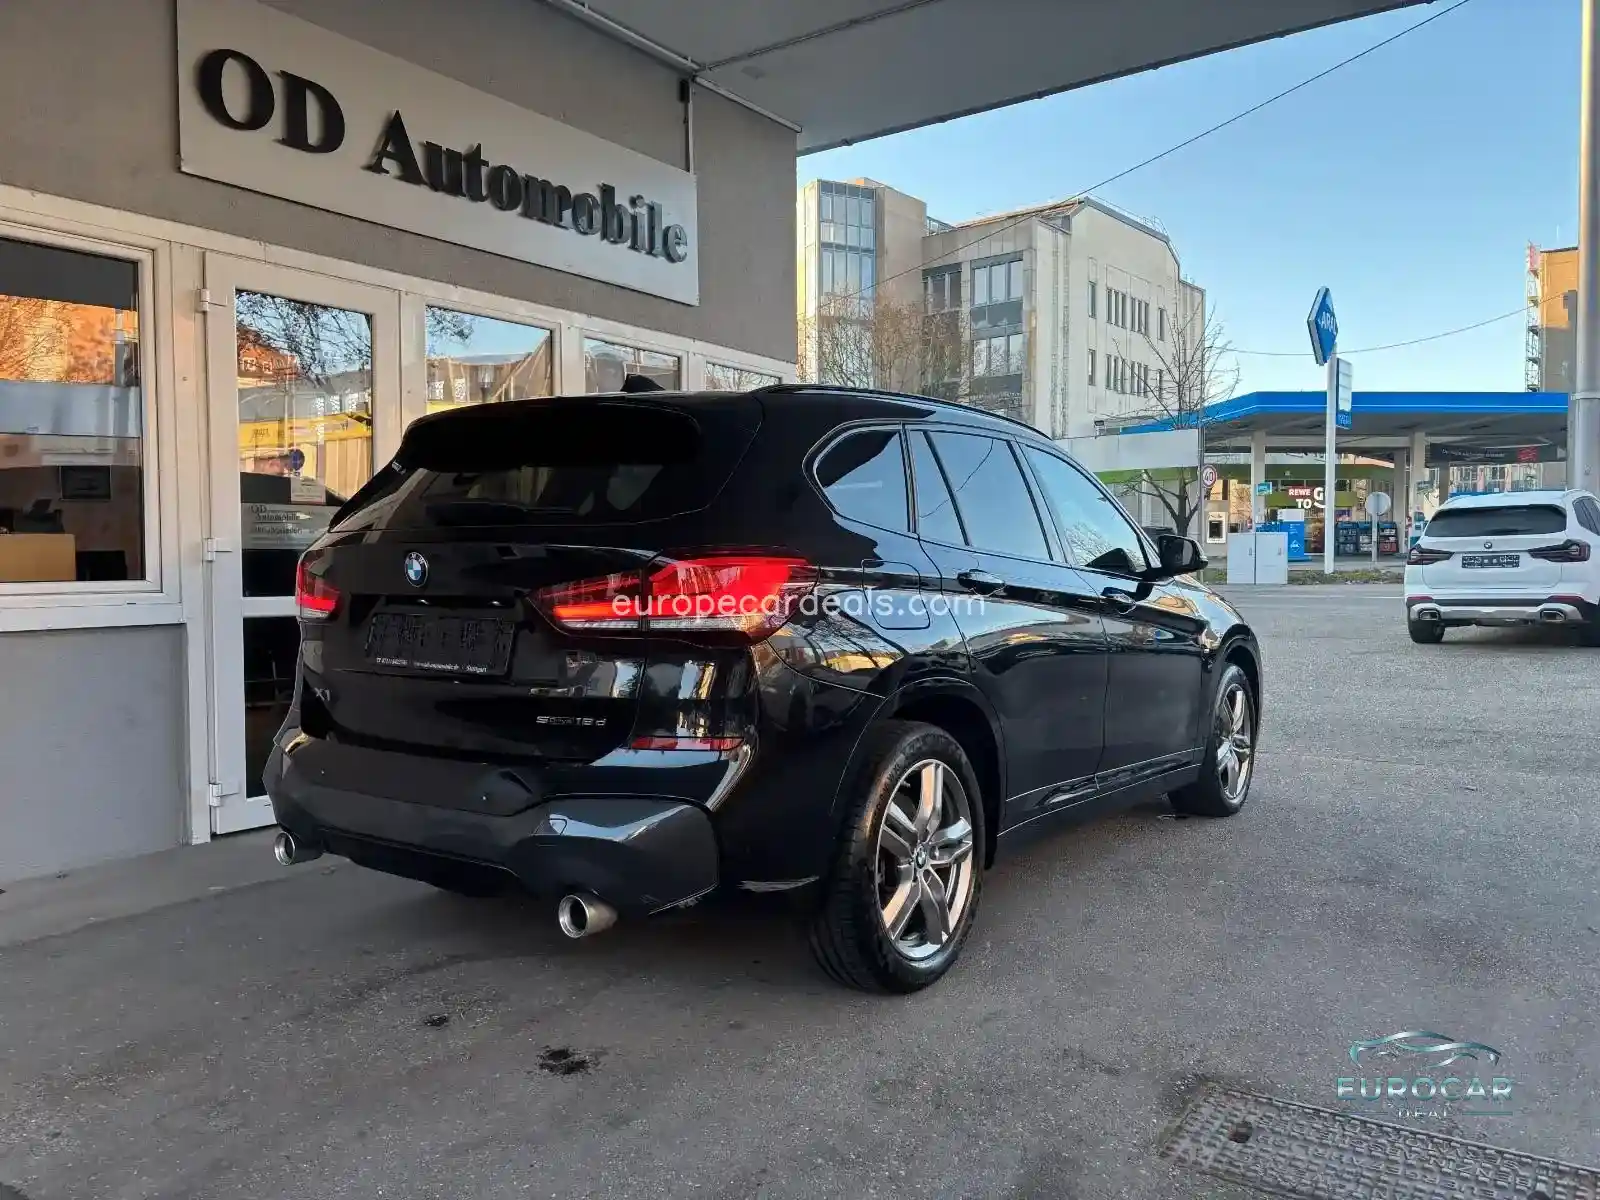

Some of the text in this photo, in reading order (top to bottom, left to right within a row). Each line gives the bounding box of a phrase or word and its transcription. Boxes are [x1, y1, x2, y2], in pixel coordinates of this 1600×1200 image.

[197, 48, 689, 264] OD Automobile
[1204, 471, 1214, 482] 40
[1288, 488, 1311, 496] REWE
[1295, 498, 1312, 509] TO
[314, 687, 331, 701] X1
